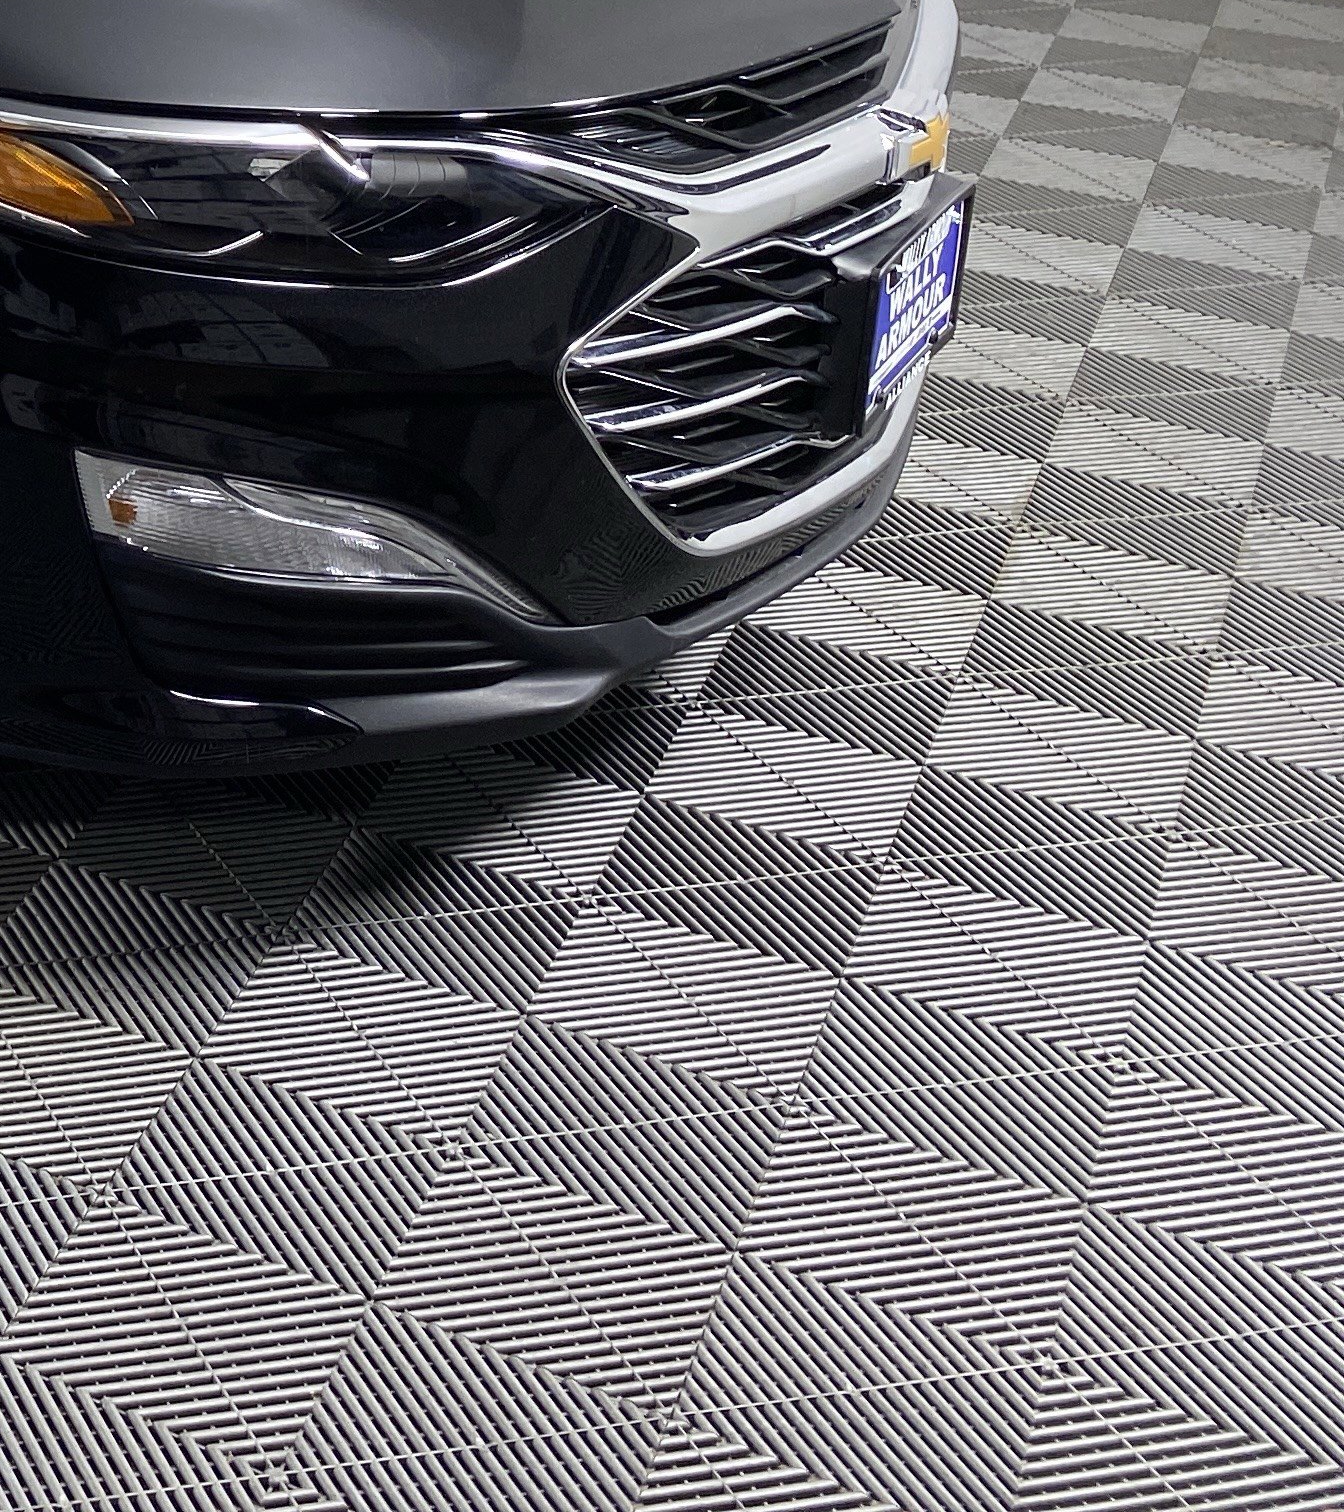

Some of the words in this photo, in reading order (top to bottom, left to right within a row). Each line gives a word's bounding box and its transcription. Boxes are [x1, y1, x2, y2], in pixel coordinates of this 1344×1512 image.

[874, 272, 947, 371] ARMOUR
[888, 241, 944, 323] WALLY
[884, 350, 933, 411] ALLIANCE
